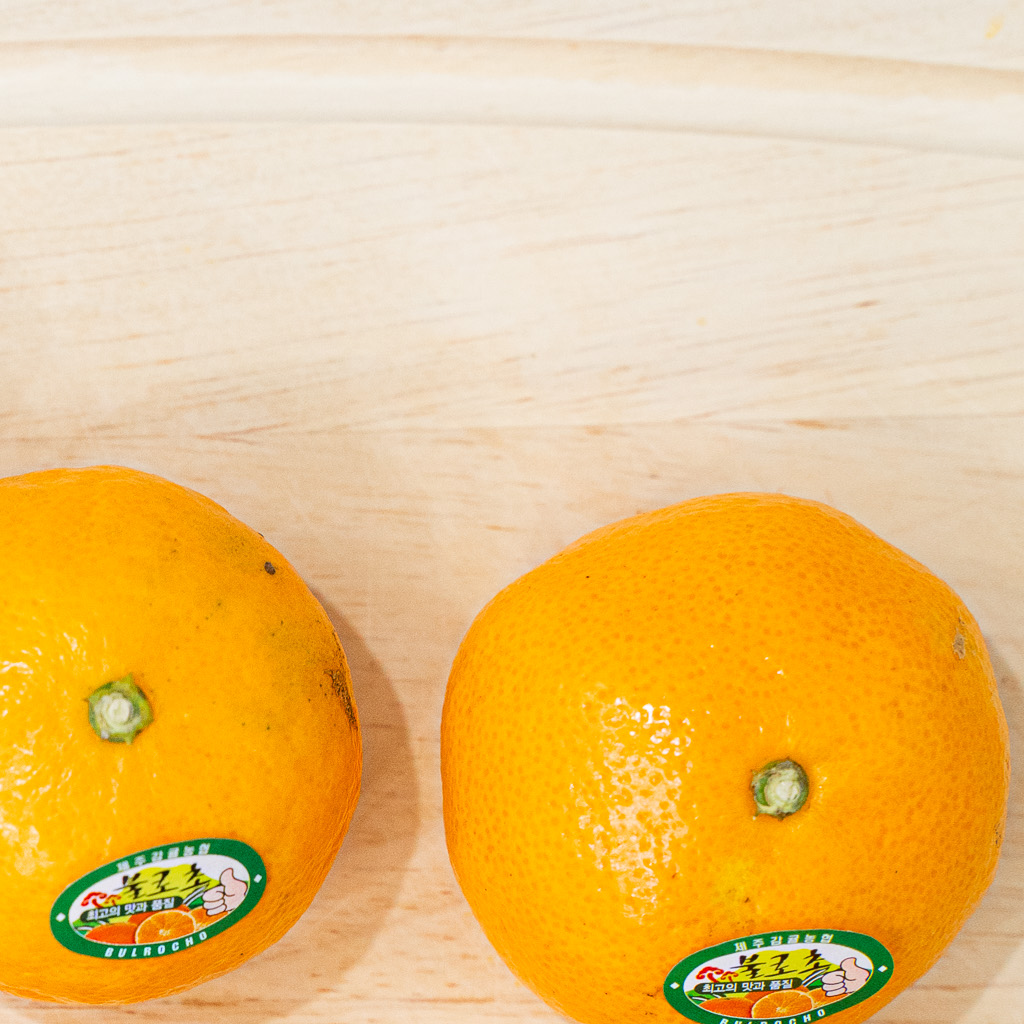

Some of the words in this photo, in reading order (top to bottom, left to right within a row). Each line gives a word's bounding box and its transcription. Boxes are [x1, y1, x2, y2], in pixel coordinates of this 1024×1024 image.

[124, 903, 148, 915] 맛과
[150, 896, 176, 911] 품질
[104, 931, 209, 958] BULROCHO
[702, 982, 738, 994] 최고의
[741, 981, 766, 993] 맛과
[769, 978, 794, 990] 품질
